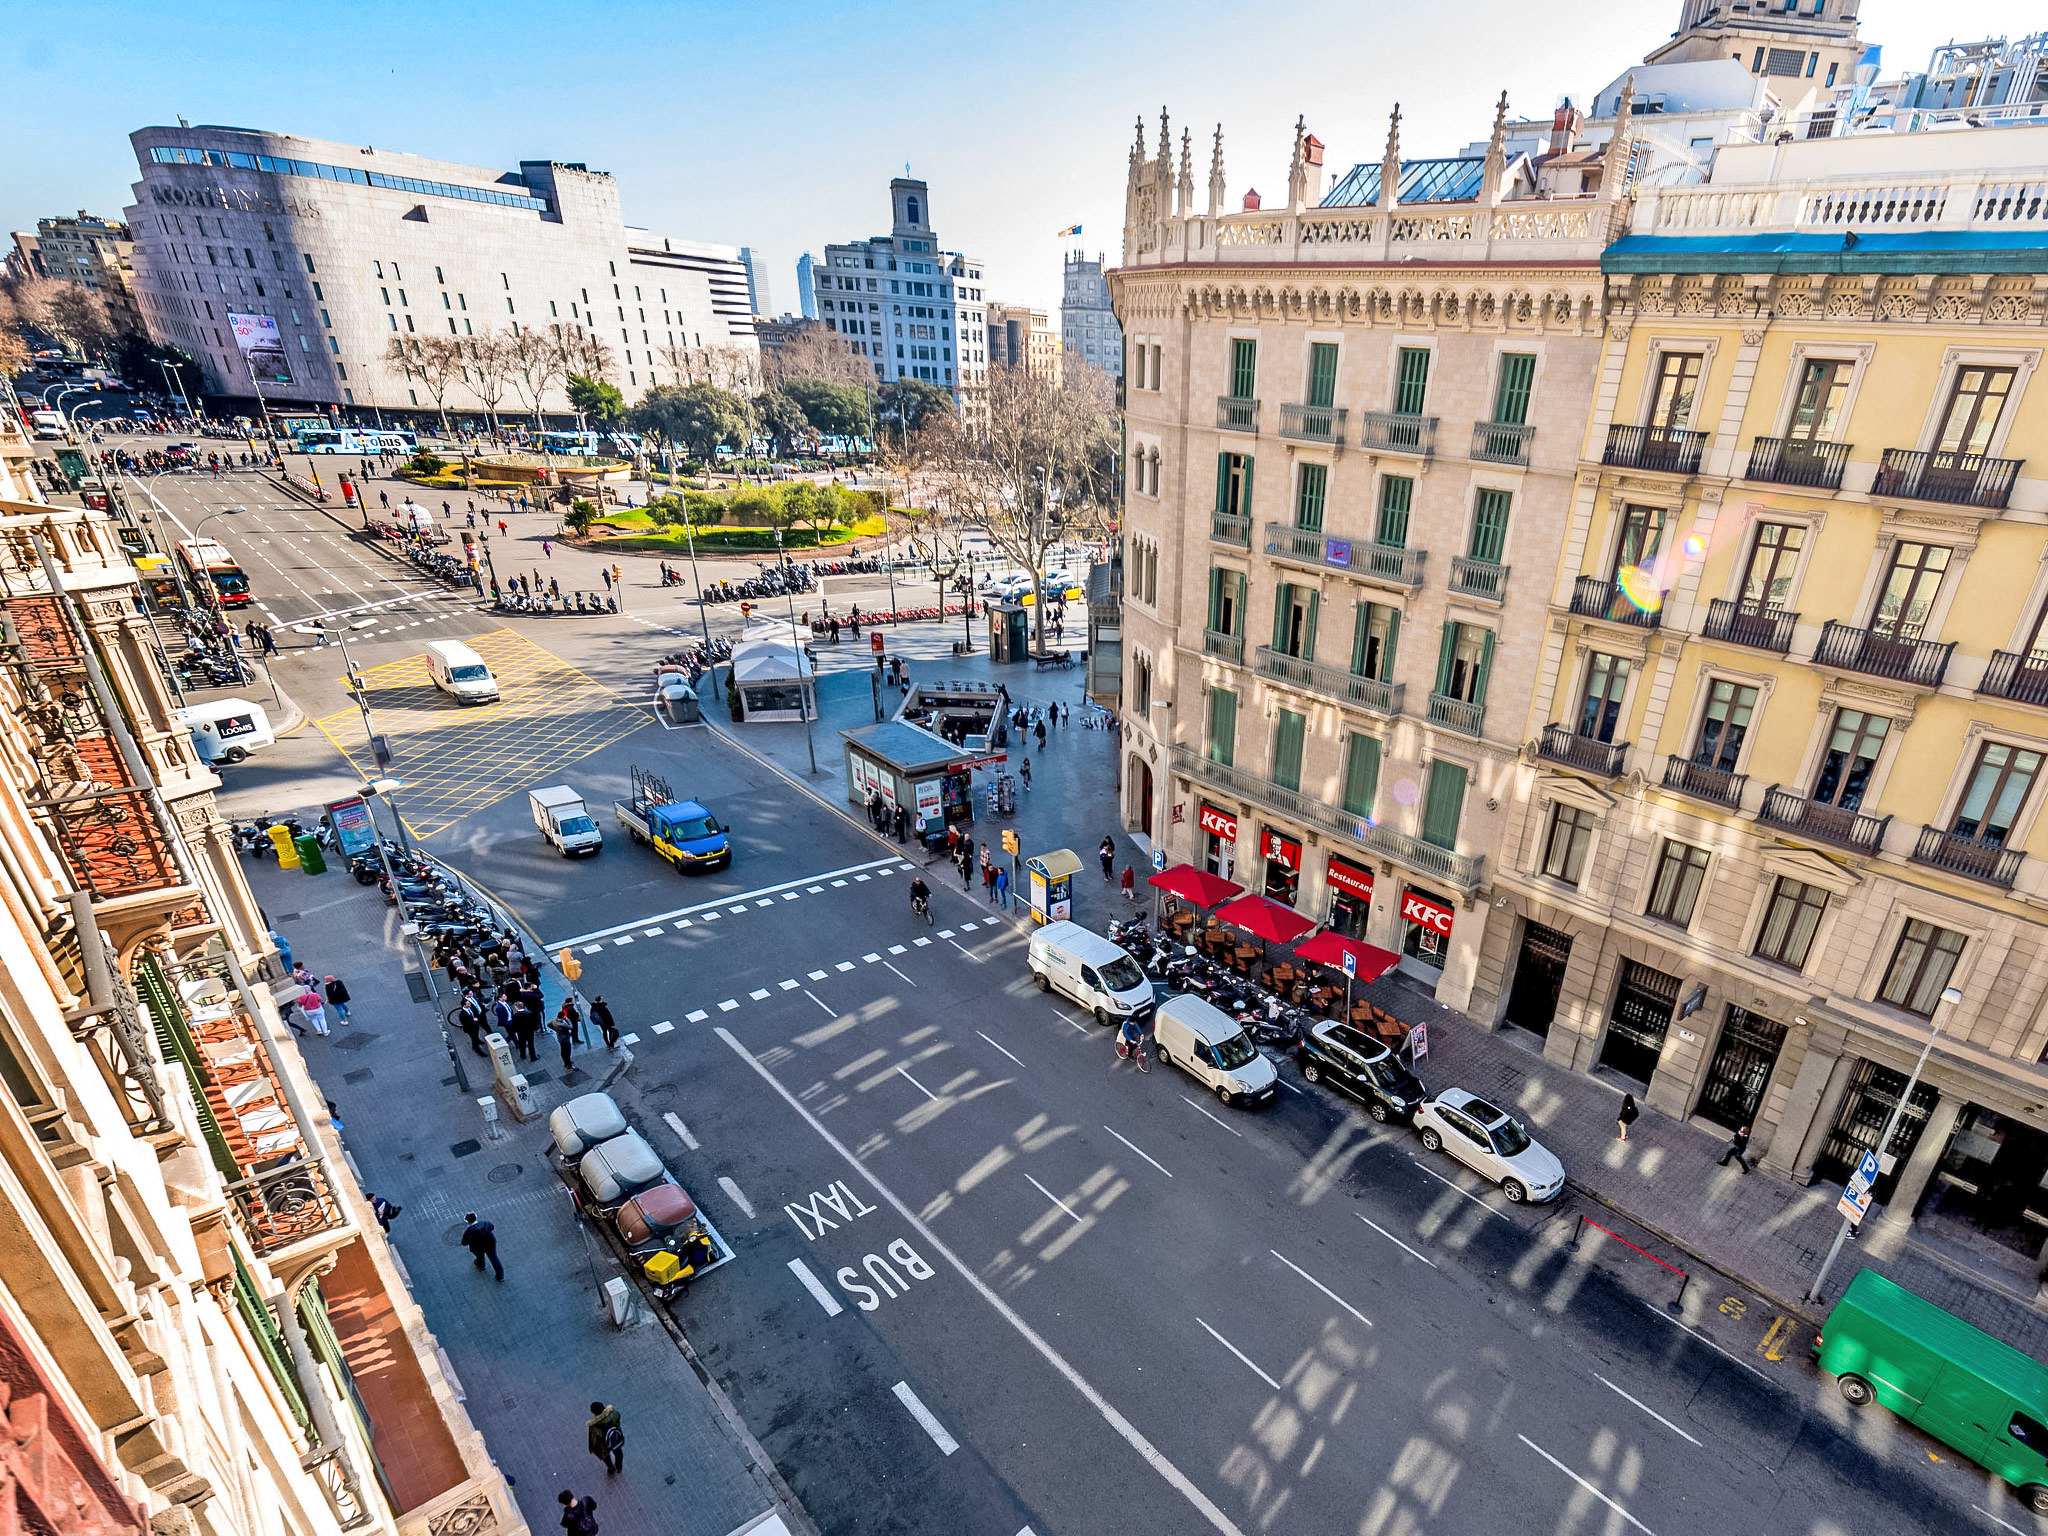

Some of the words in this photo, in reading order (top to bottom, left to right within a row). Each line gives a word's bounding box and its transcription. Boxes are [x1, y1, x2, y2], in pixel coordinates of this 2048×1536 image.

[221, 723, 254, 736] LOOMIS
[1201, 810, 1237, 838] KFC
[1154, 852, 1162, 864] P
[1328, 868, 1373, 894] Restaurant
[1403, 898, 1453, 931] KFC
[1324, 961, 1343, 971] KFC
[1345, 954, 1353, 966] P
[1862, 1155, 1876, 1173] P
[783, 1179, 878, 1241] TAXI
[836, 1237, 936, 1311] BUS
